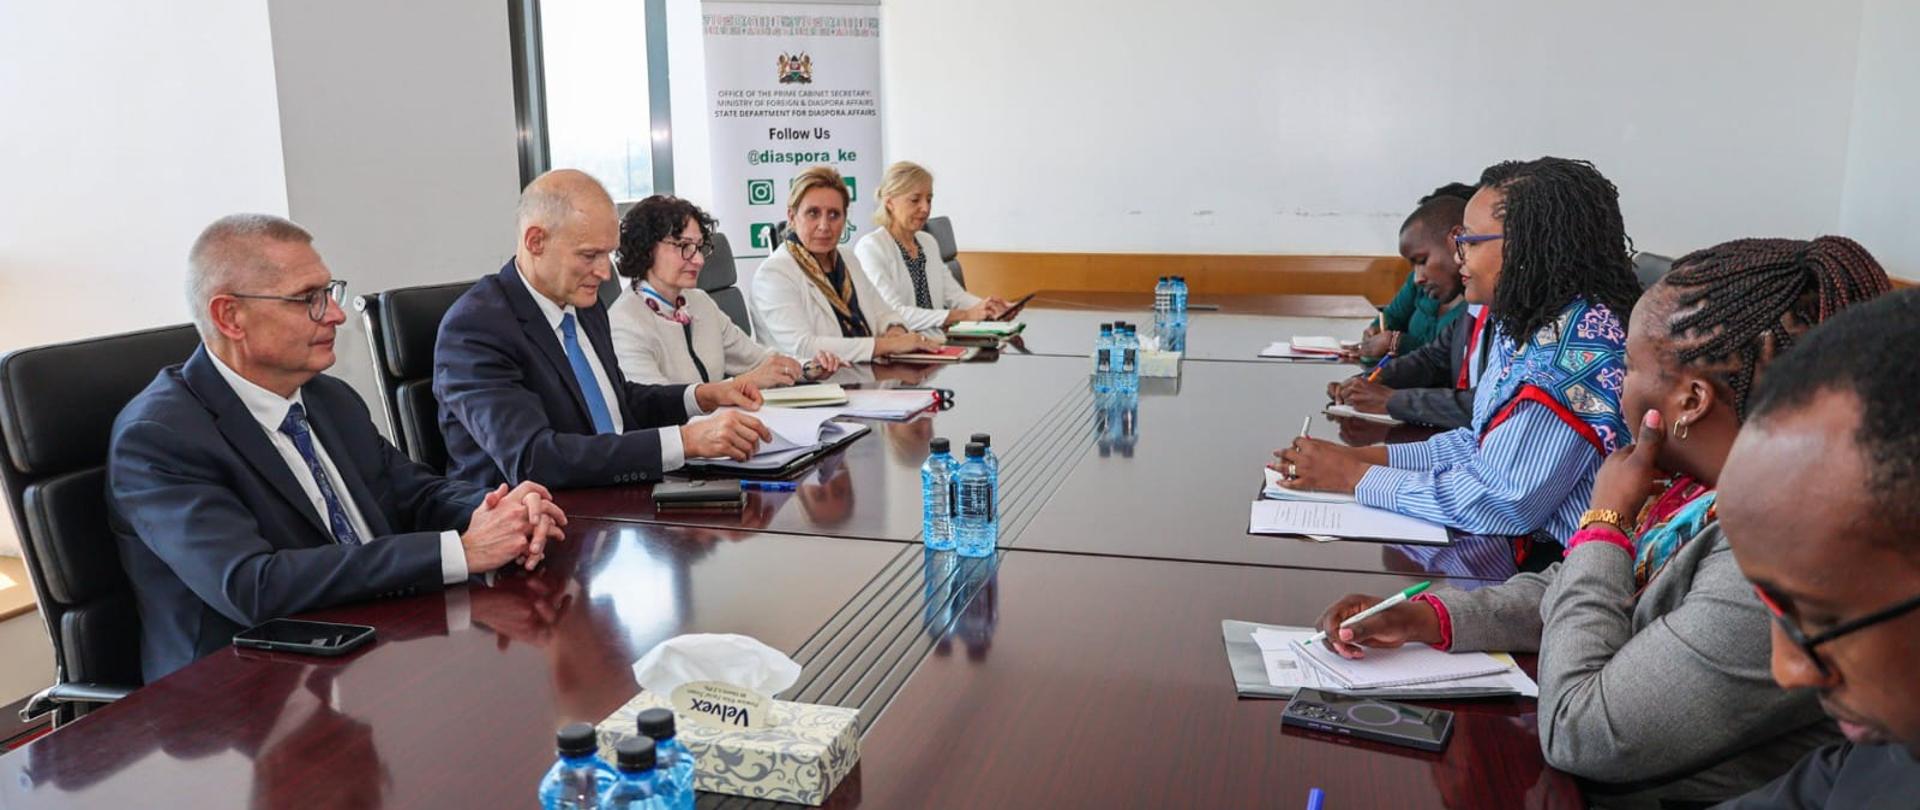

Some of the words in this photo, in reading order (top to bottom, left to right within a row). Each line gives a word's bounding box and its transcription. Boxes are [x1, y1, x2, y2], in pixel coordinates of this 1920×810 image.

[714, 110, 737, 118] STATE
[739, 110, 790, 118] DEPARTMENT
[847, 109, 876, 117] AFFAIRS
[769, 127, 810, 140] Follow
[814, 127, 831, 140] Us
[748, 149, 857, 165] @diaspora_ke
[690, 698, 749, 727] Velvex
